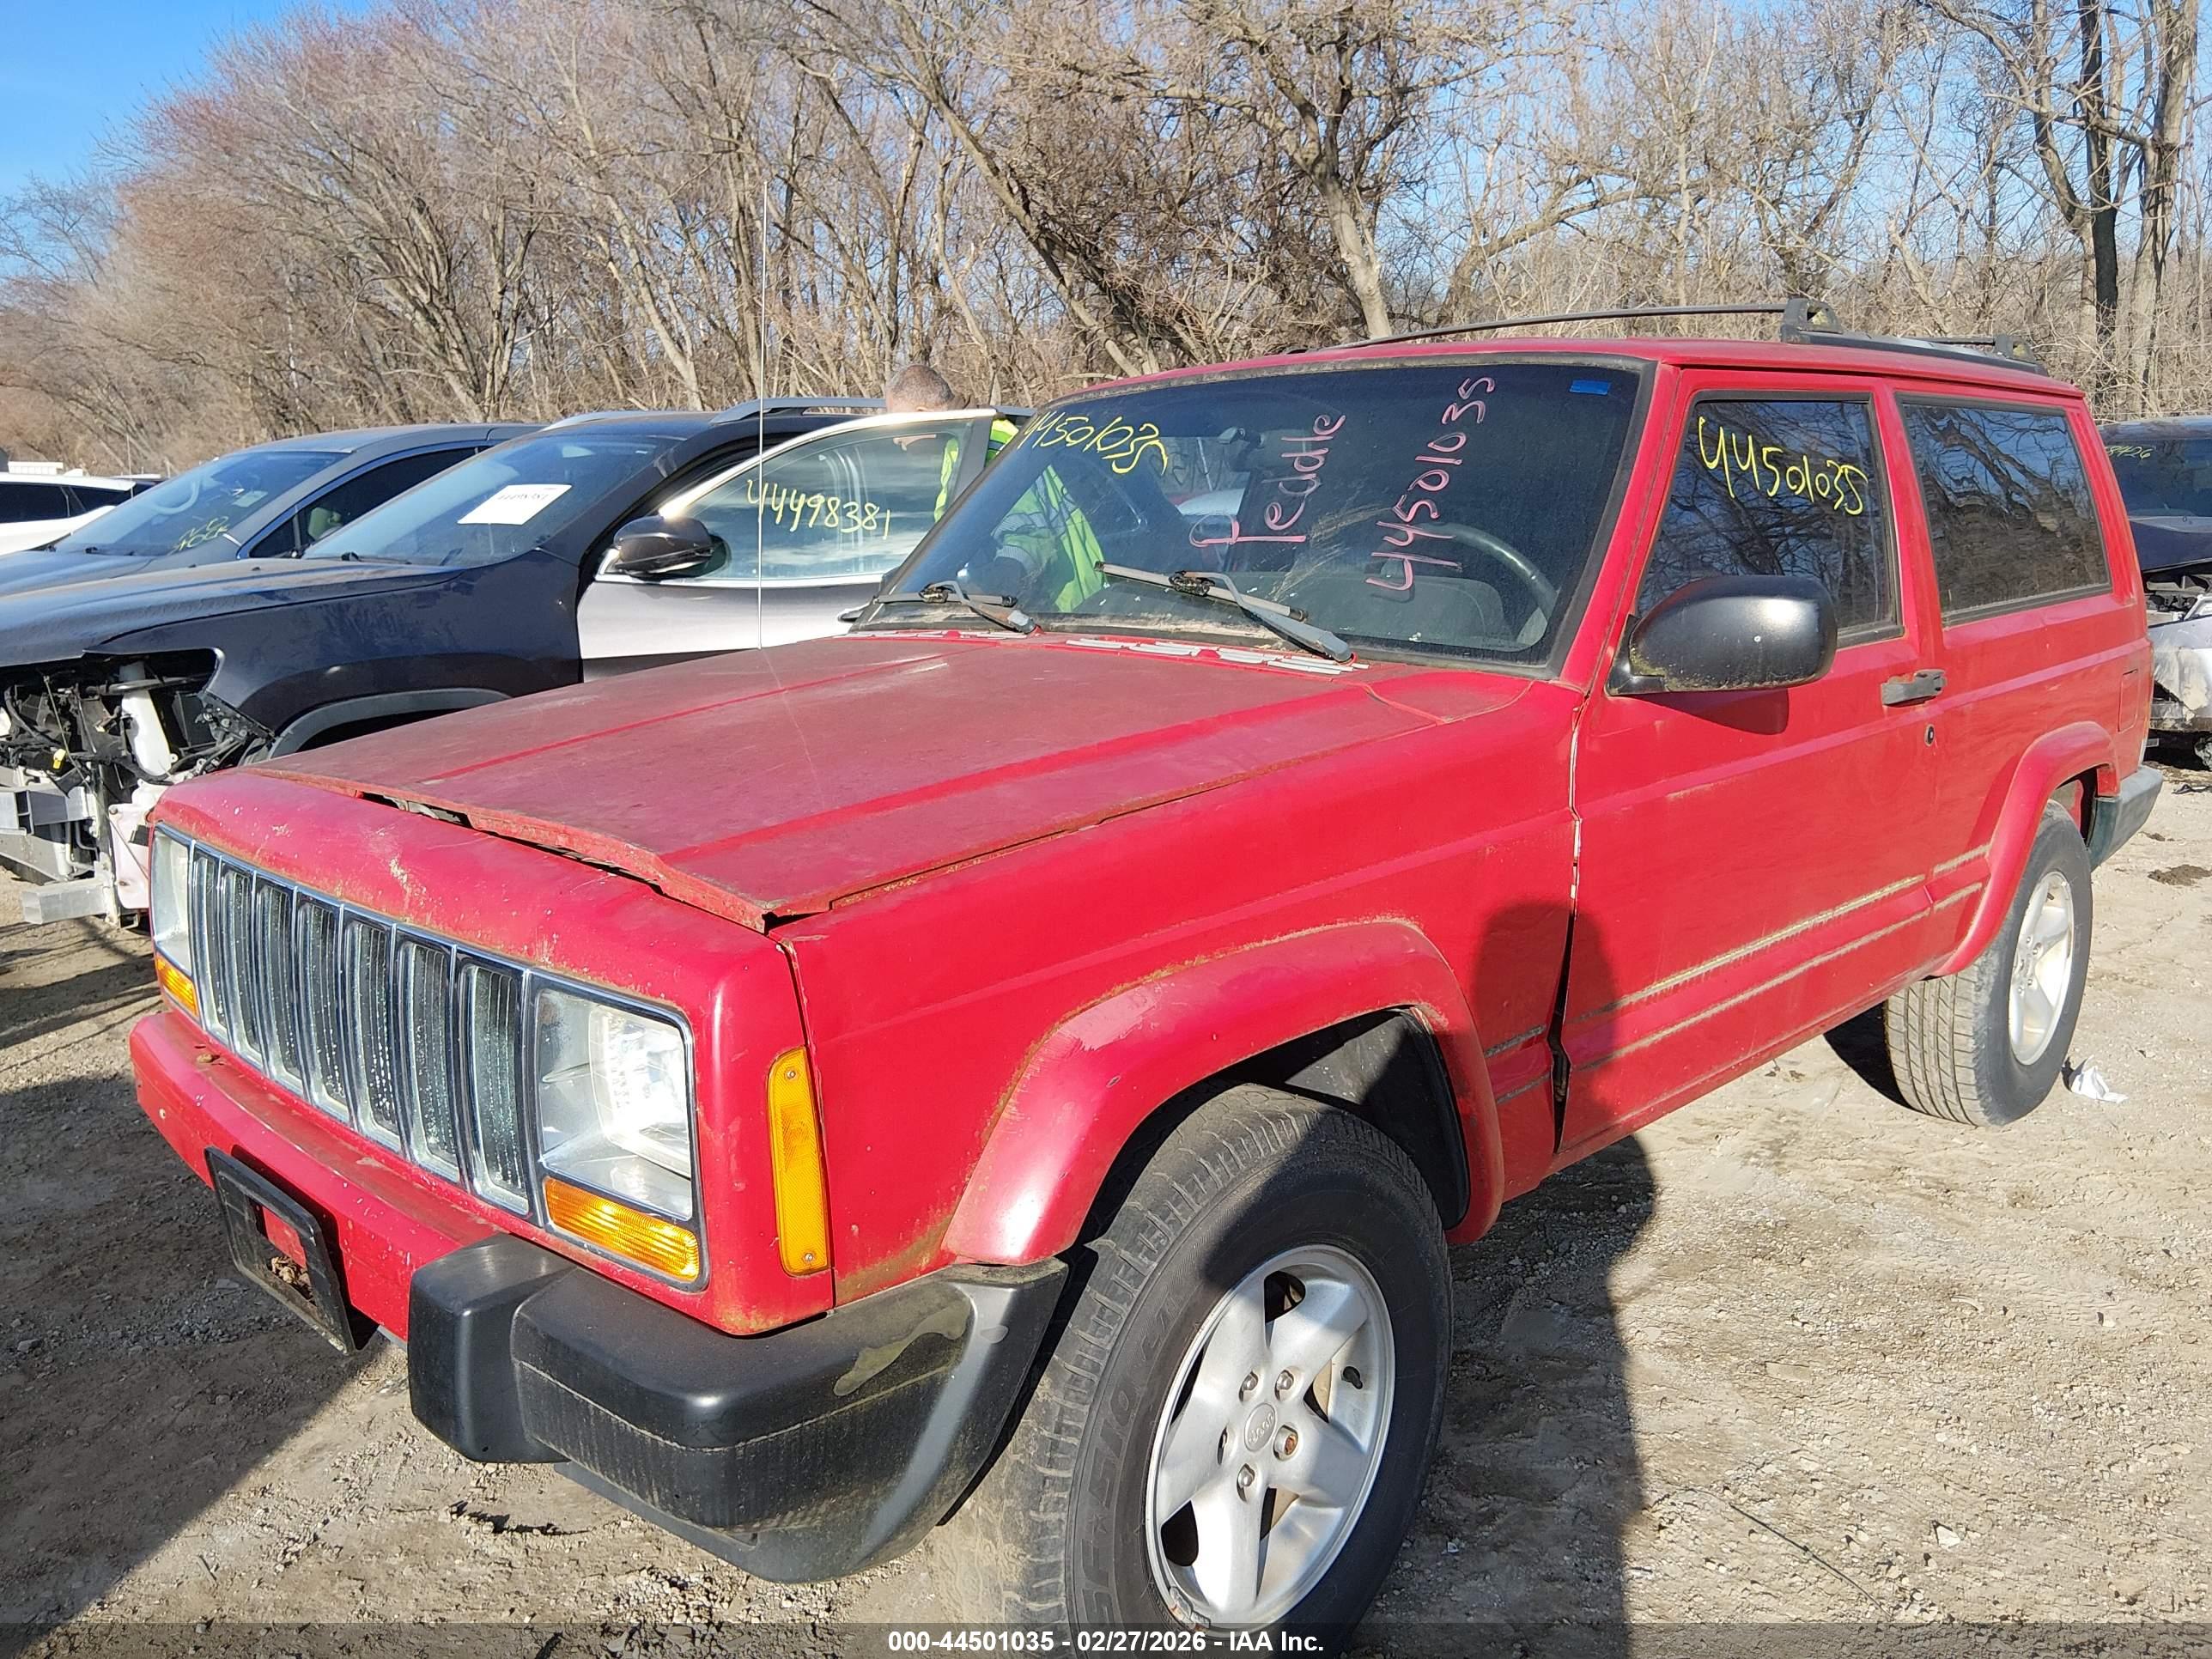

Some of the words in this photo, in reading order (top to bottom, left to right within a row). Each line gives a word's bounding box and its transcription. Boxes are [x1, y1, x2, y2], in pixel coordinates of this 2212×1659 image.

[746, 478, 891, 540] 44498381
[1188, 414, 1346, 548] Peddle
[1365, 376, 1496, 591] 44501035
[1698, 416, 1869, 515] 44501035
